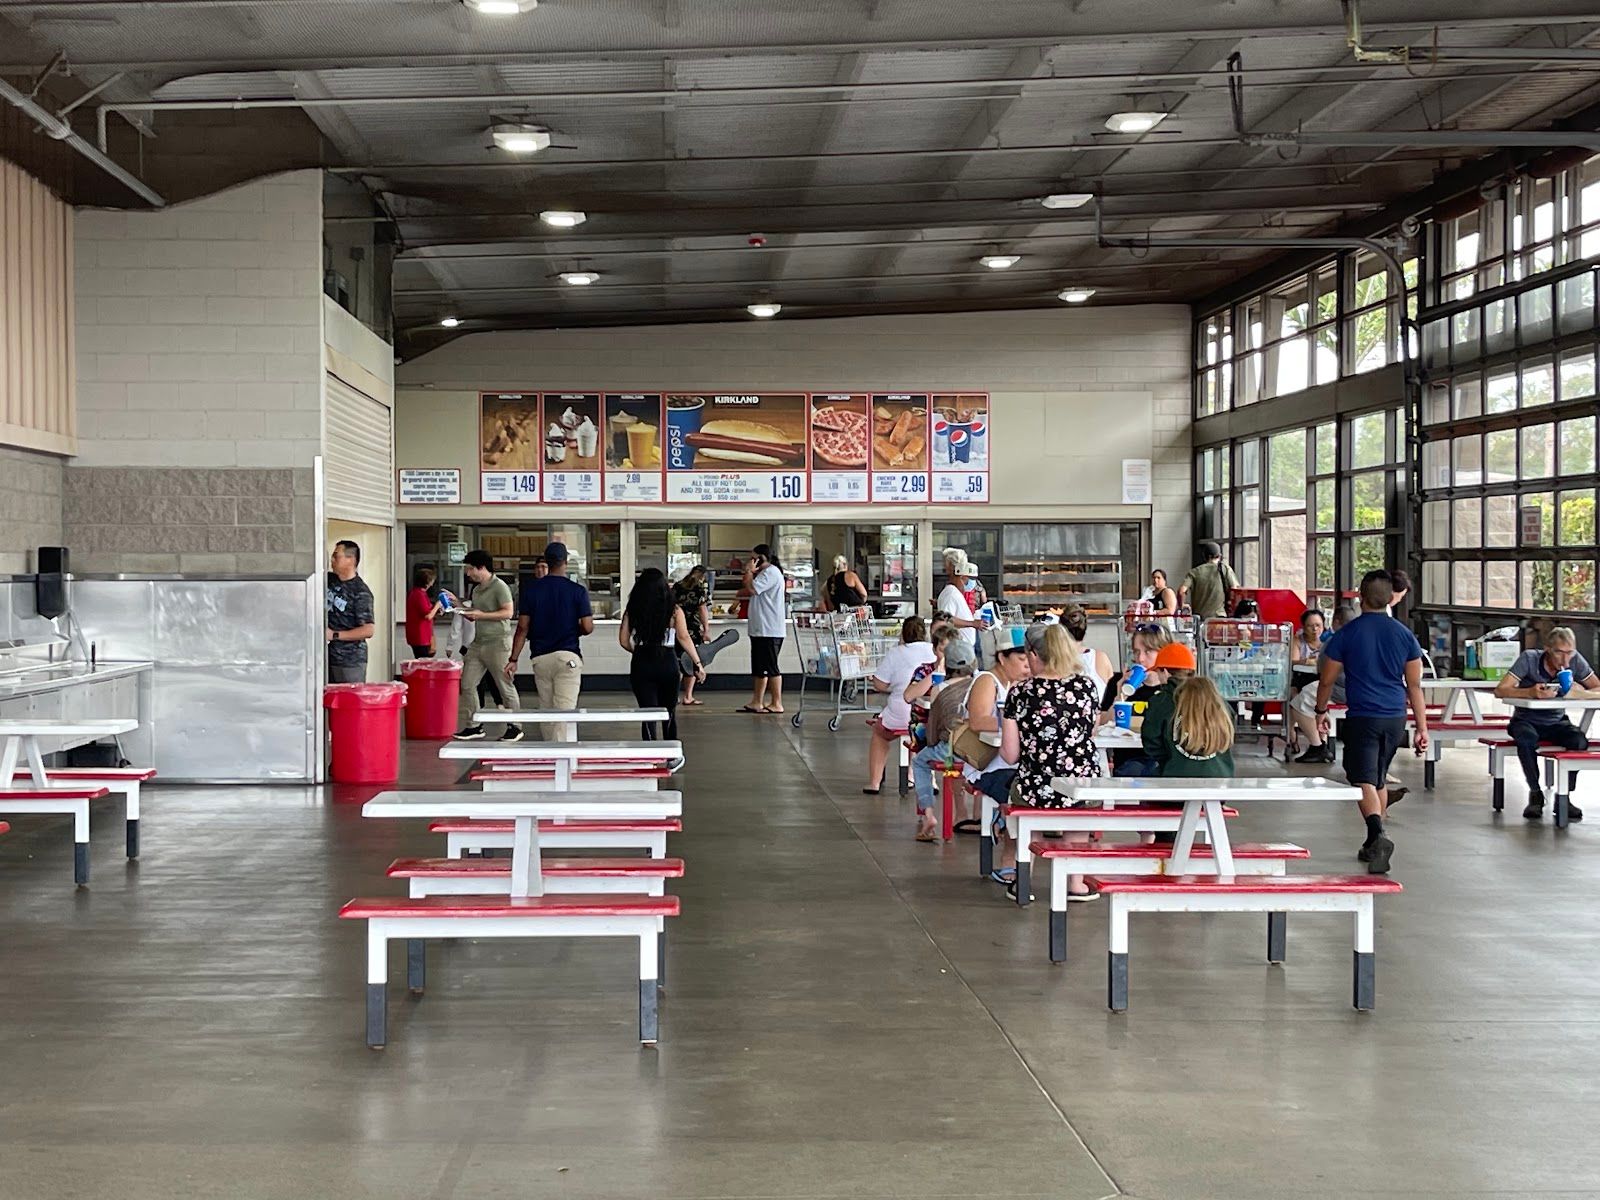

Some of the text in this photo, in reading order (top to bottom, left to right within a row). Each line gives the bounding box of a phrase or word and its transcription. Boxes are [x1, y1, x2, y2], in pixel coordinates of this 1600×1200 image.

[714, 396, 759, 404] KIRKLAND
[668, 424, 685, 467] pepsi
[512, 475, 536, 492] 1.49
[771, 475, 800, 498] 1.50
[901, 475, 926, 492] 2.99
[965, 475, 983, 492] .59
